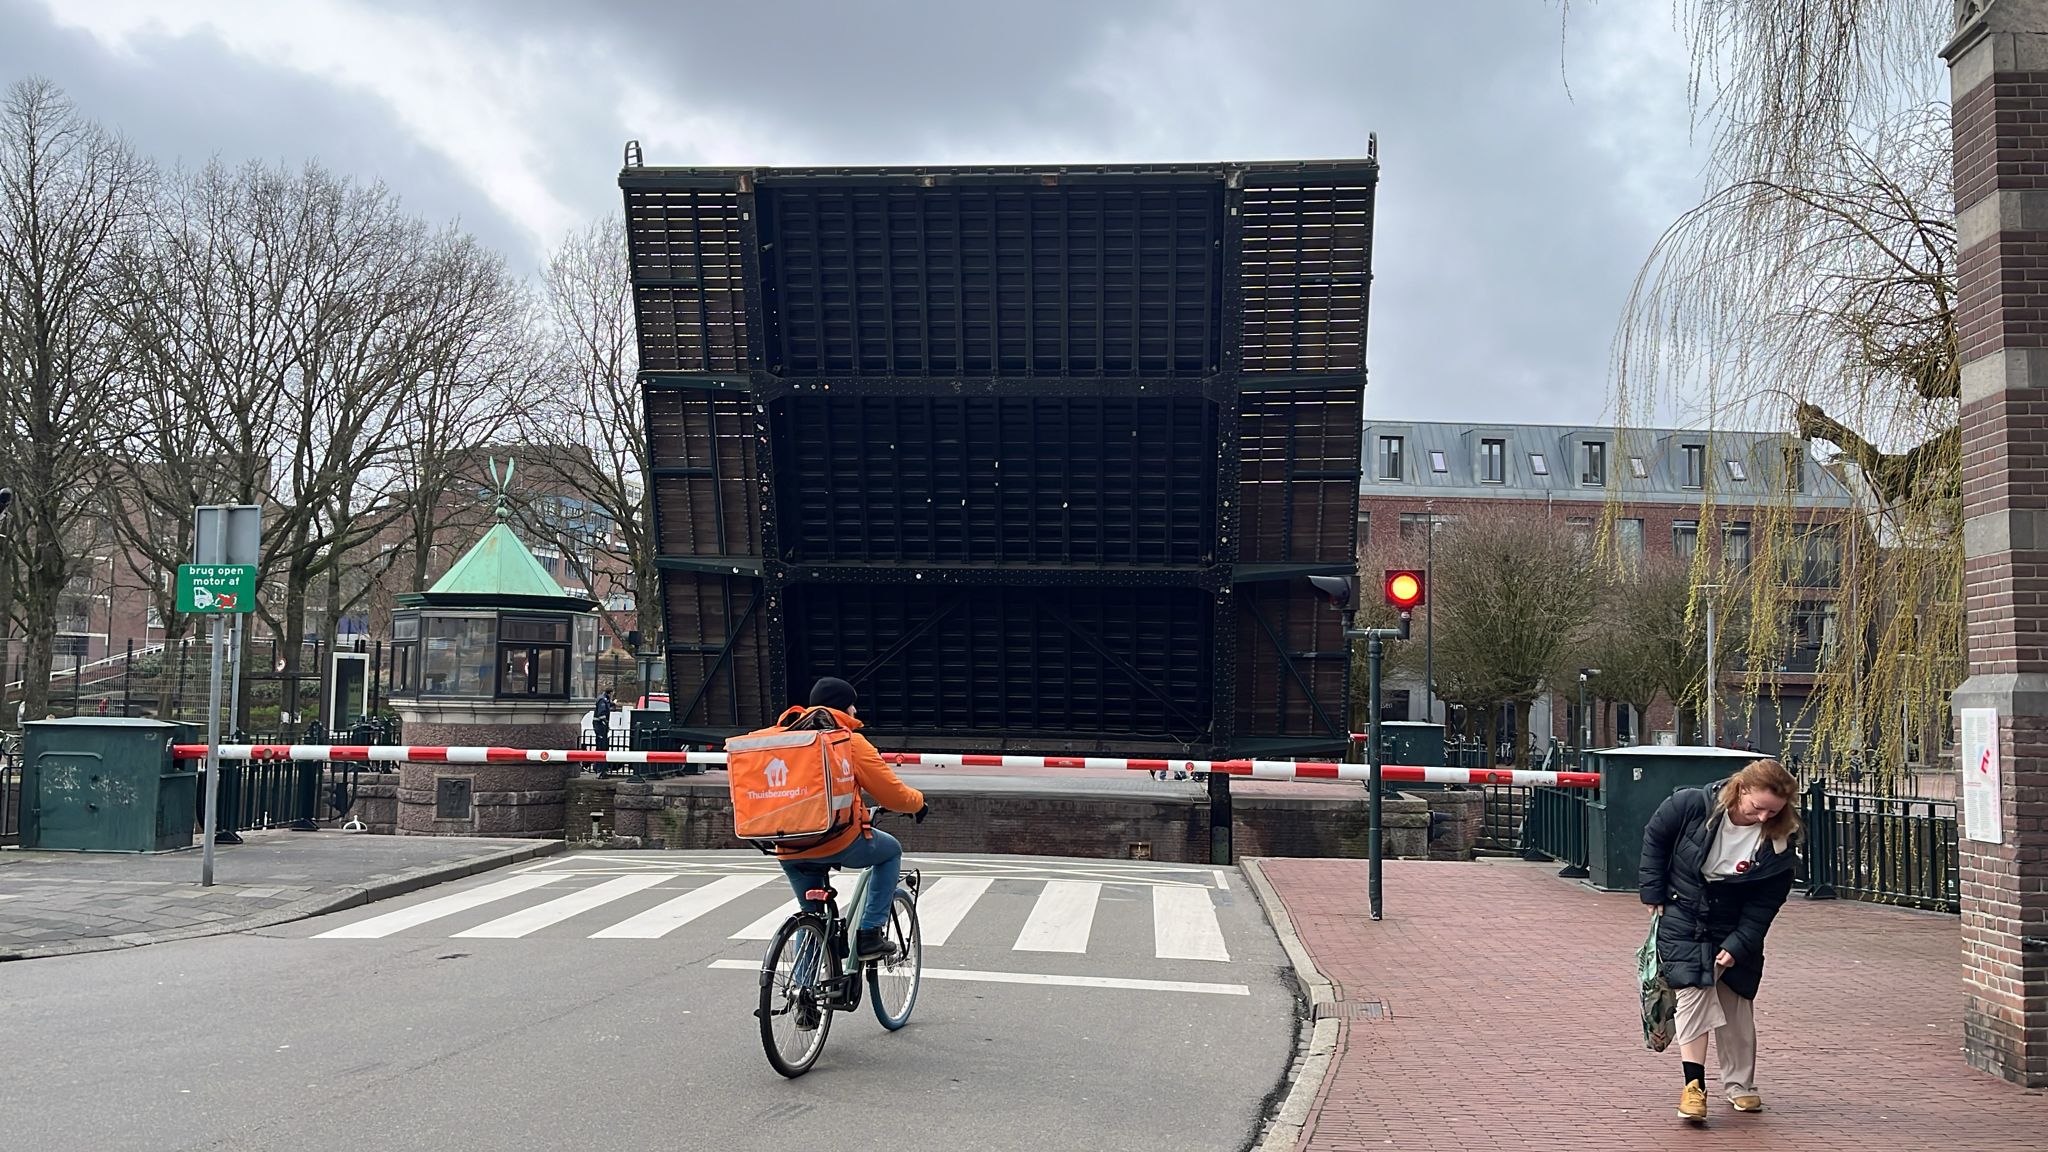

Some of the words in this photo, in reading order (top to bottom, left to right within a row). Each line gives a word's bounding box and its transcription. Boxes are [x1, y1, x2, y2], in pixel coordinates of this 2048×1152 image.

[189, 566, 214, 576] brug
[217, 567, 244, 576] open
[193, 577, 225, 586] motor
[228, 577, 240, 586] af
[747, 786, 808, 799] Thuisbezorgd.nl
